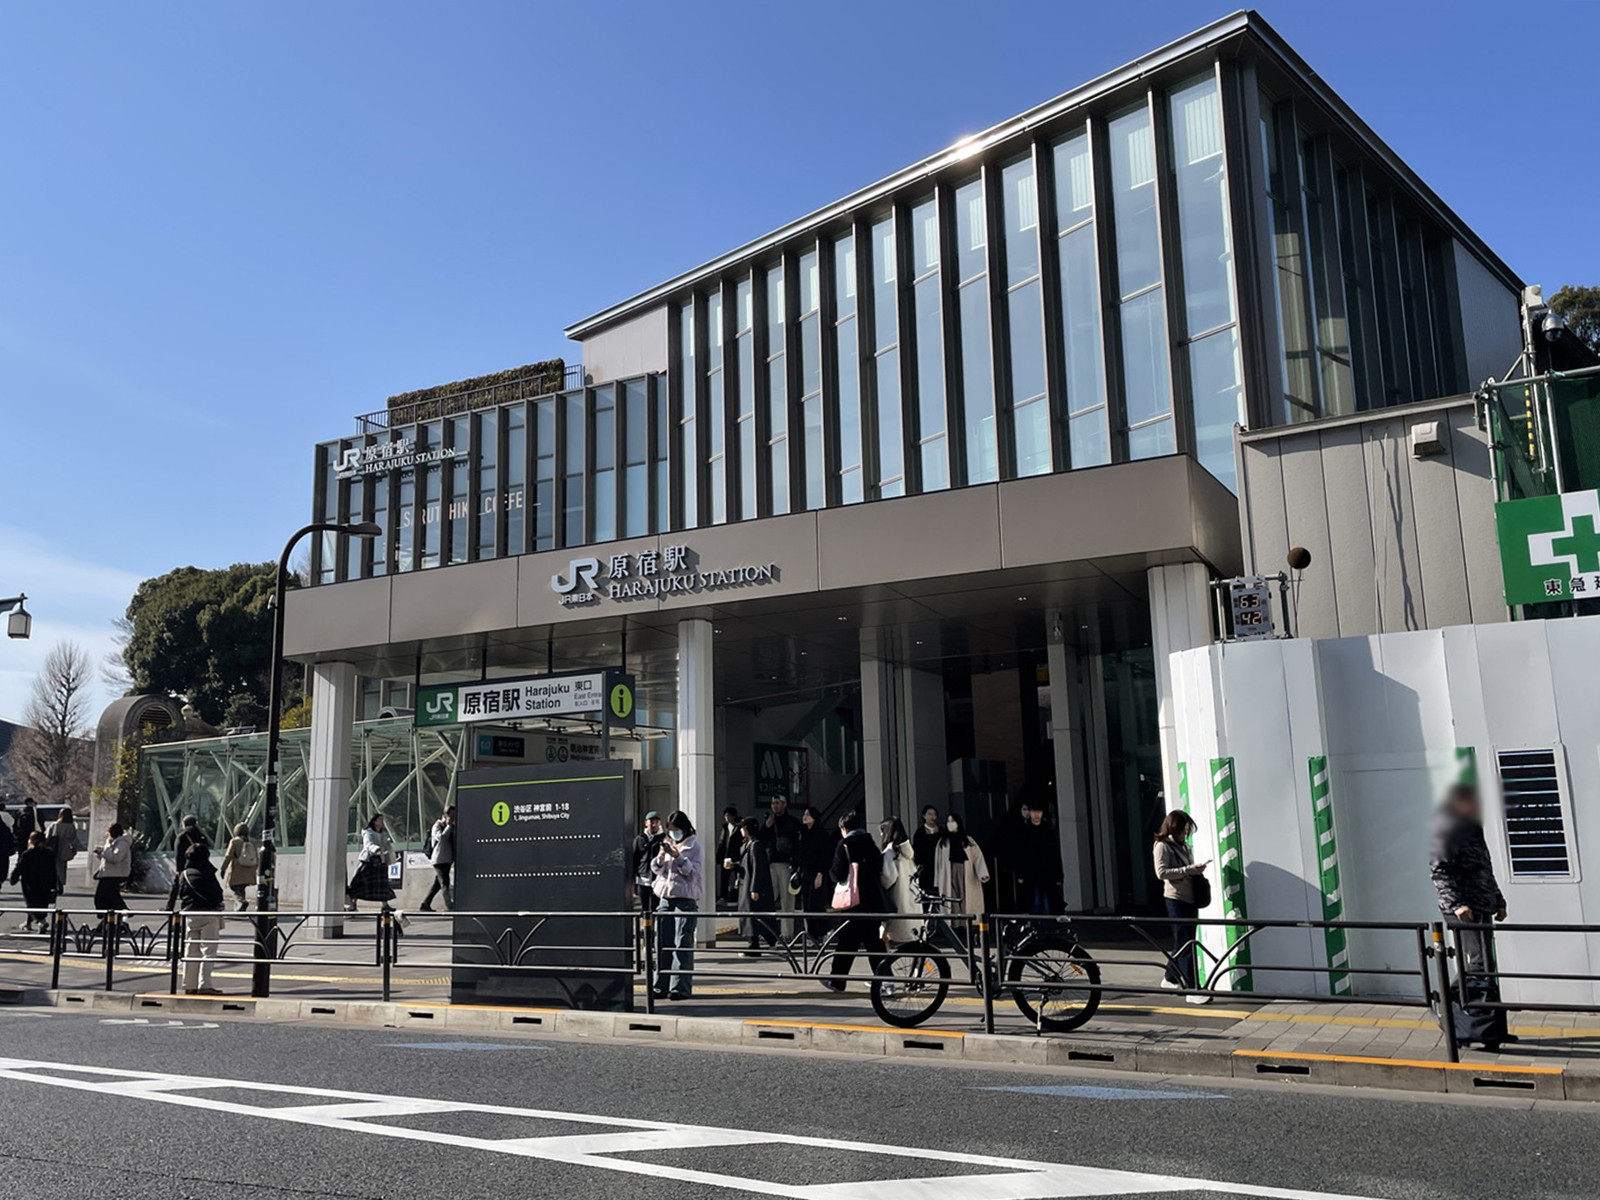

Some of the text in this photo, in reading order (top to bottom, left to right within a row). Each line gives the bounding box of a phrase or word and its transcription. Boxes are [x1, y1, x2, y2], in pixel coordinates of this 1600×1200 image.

[365, 438, 410, 461] 原宿駅
[333, 448, 360, 471] JR
[365, 447, 456, 473] HARAJUKU STATION
[609, 545, 687, 579] 原宿駅
[551, 557, 599, 593] JR
[609, 564, 774, 599] HARAJUKU STATION
[558, 593, 594, 605] JR東日本
[1240, 594, 1260, 608] 63
[1242, 611, 1262, 625] 42
[525, 684, 570, 697] Harajuku
[575, 680, 592, 691] 東口
[426, 692, 454, 713] JR
[463, 688, 520, 715] 原宿駅
[525, 699, 560, 710] Station
[555, 803, 570, 811] 1-18
[560, 812, 570, 820] City
